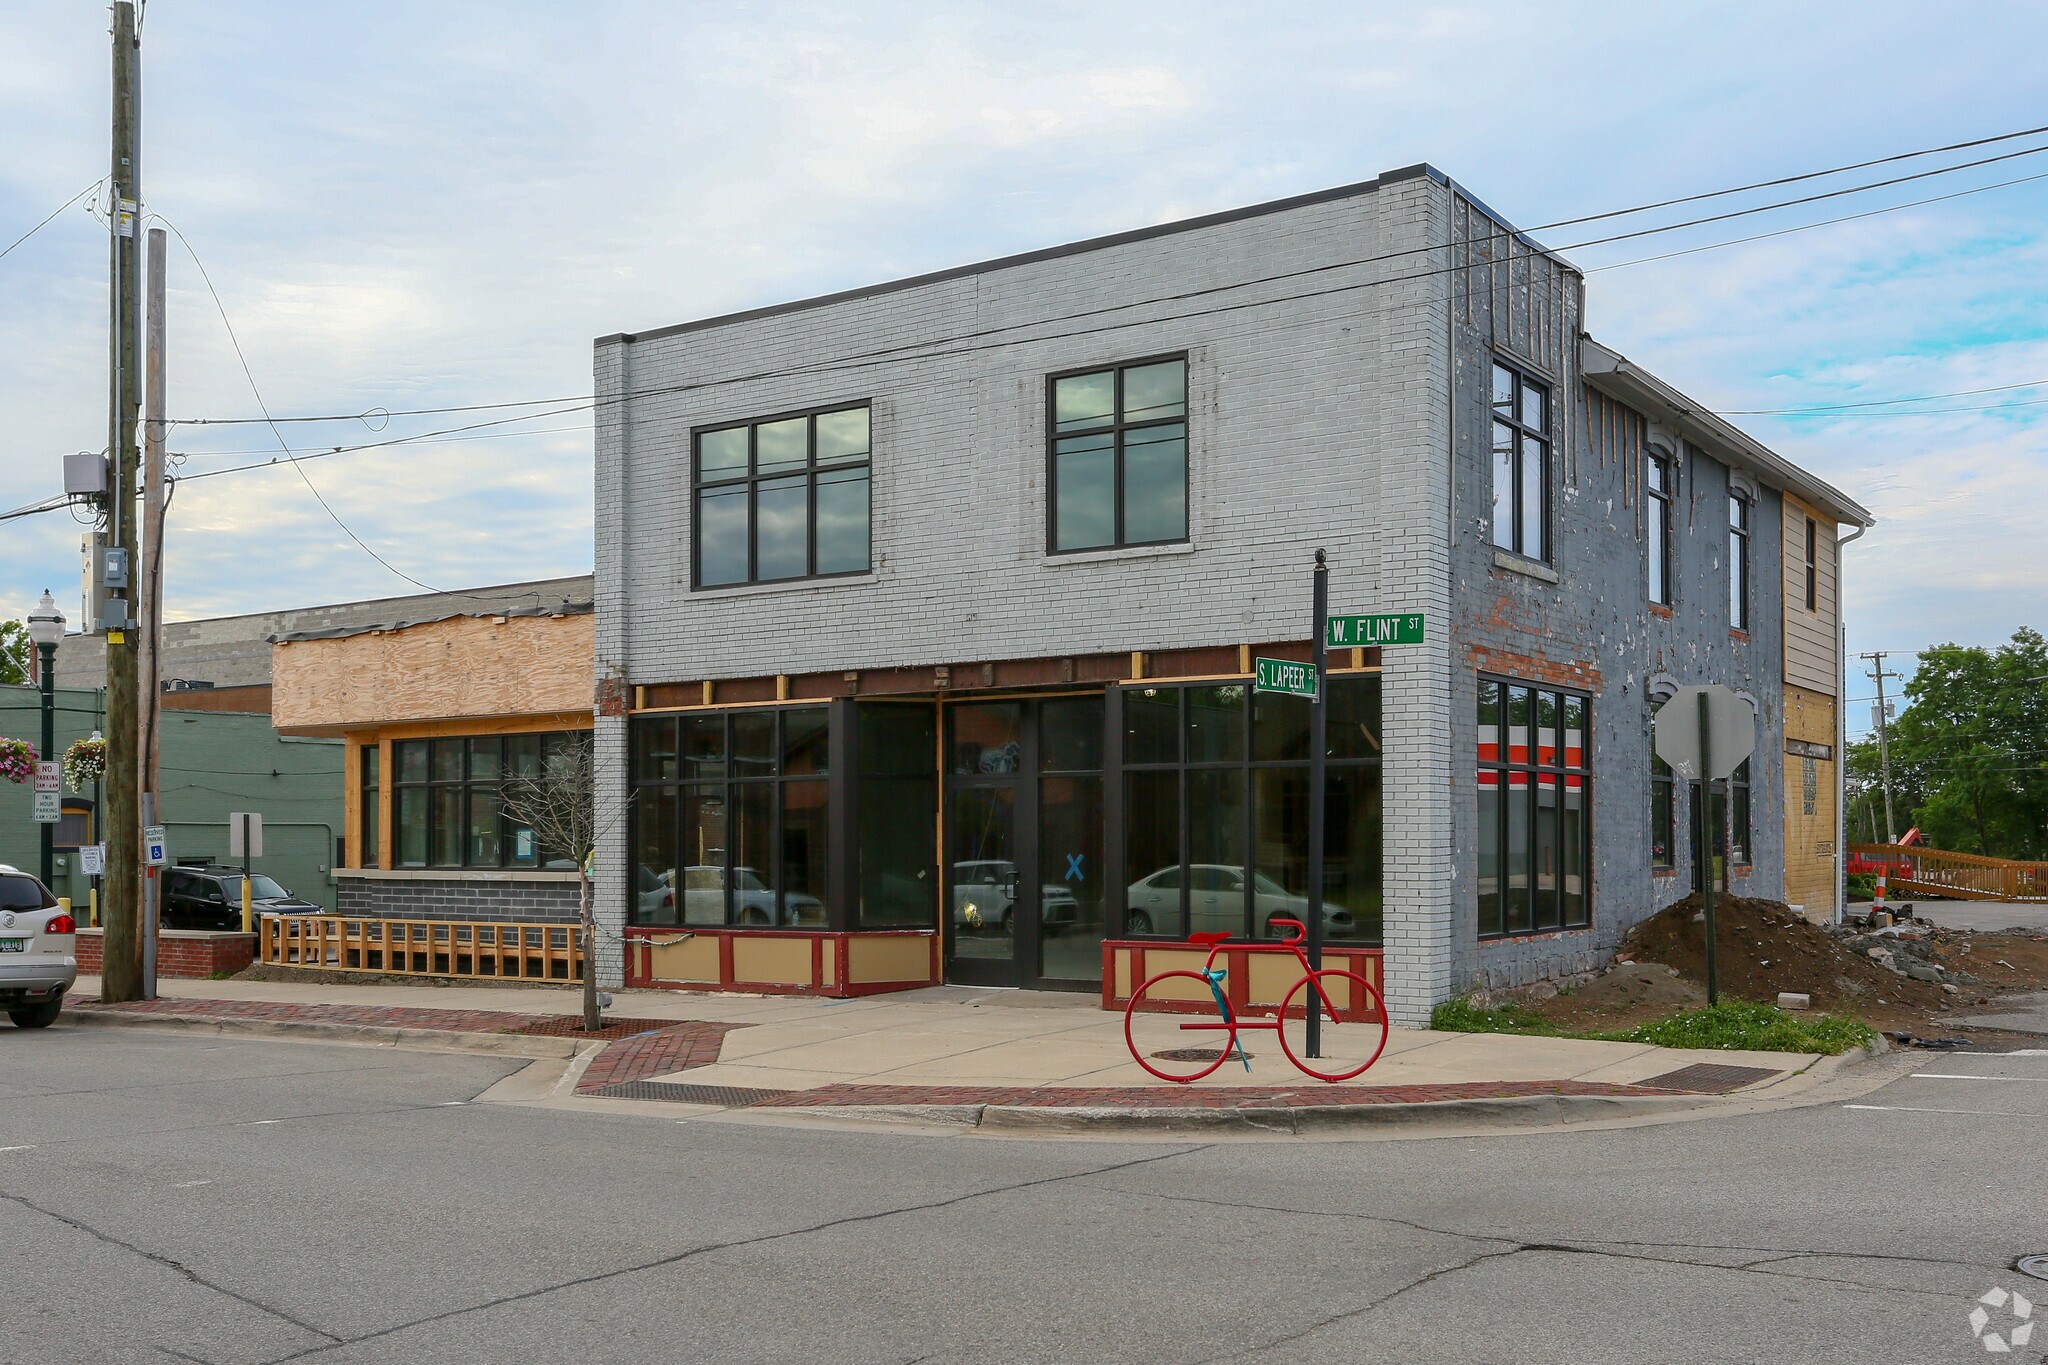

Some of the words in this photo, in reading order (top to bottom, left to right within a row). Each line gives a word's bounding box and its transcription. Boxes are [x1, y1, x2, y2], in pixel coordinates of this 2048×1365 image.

[1333, 620, 1348, 642] W.
[1356, 618, 1401, 642] FLINT
[1408, 617, 1420, 630] ST
[1259, 662, 1267, 686] S.
[1271, 664, 1305, 690] LAPEER
[1308, 669, 1314, 680] ST
[42, 765, 53, 773] NO
